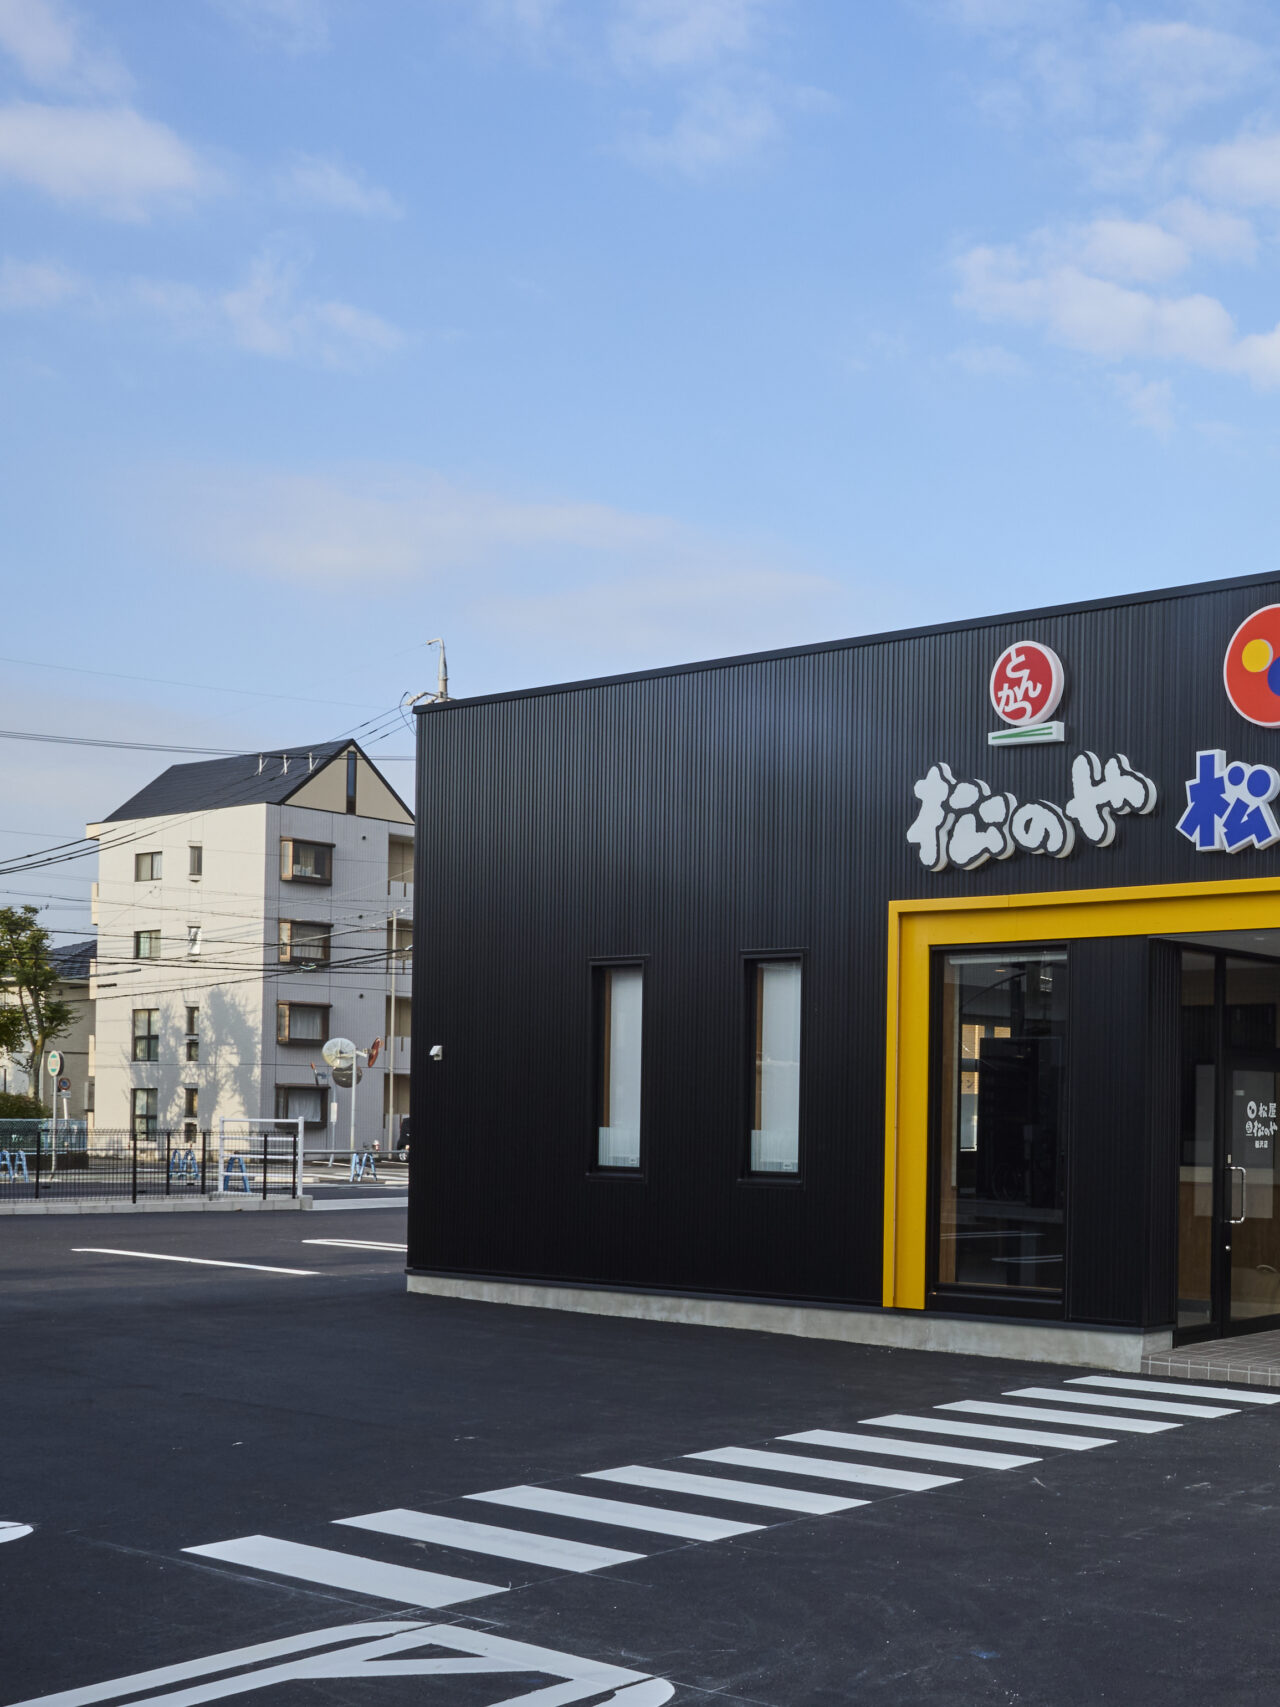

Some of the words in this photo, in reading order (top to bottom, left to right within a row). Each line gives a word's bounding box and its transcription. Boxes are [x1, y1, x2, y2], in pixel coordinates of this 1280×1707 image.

[907, 750, 1157, 871] 松のや
[1258, 1102, 1276, 1117] 松屋
